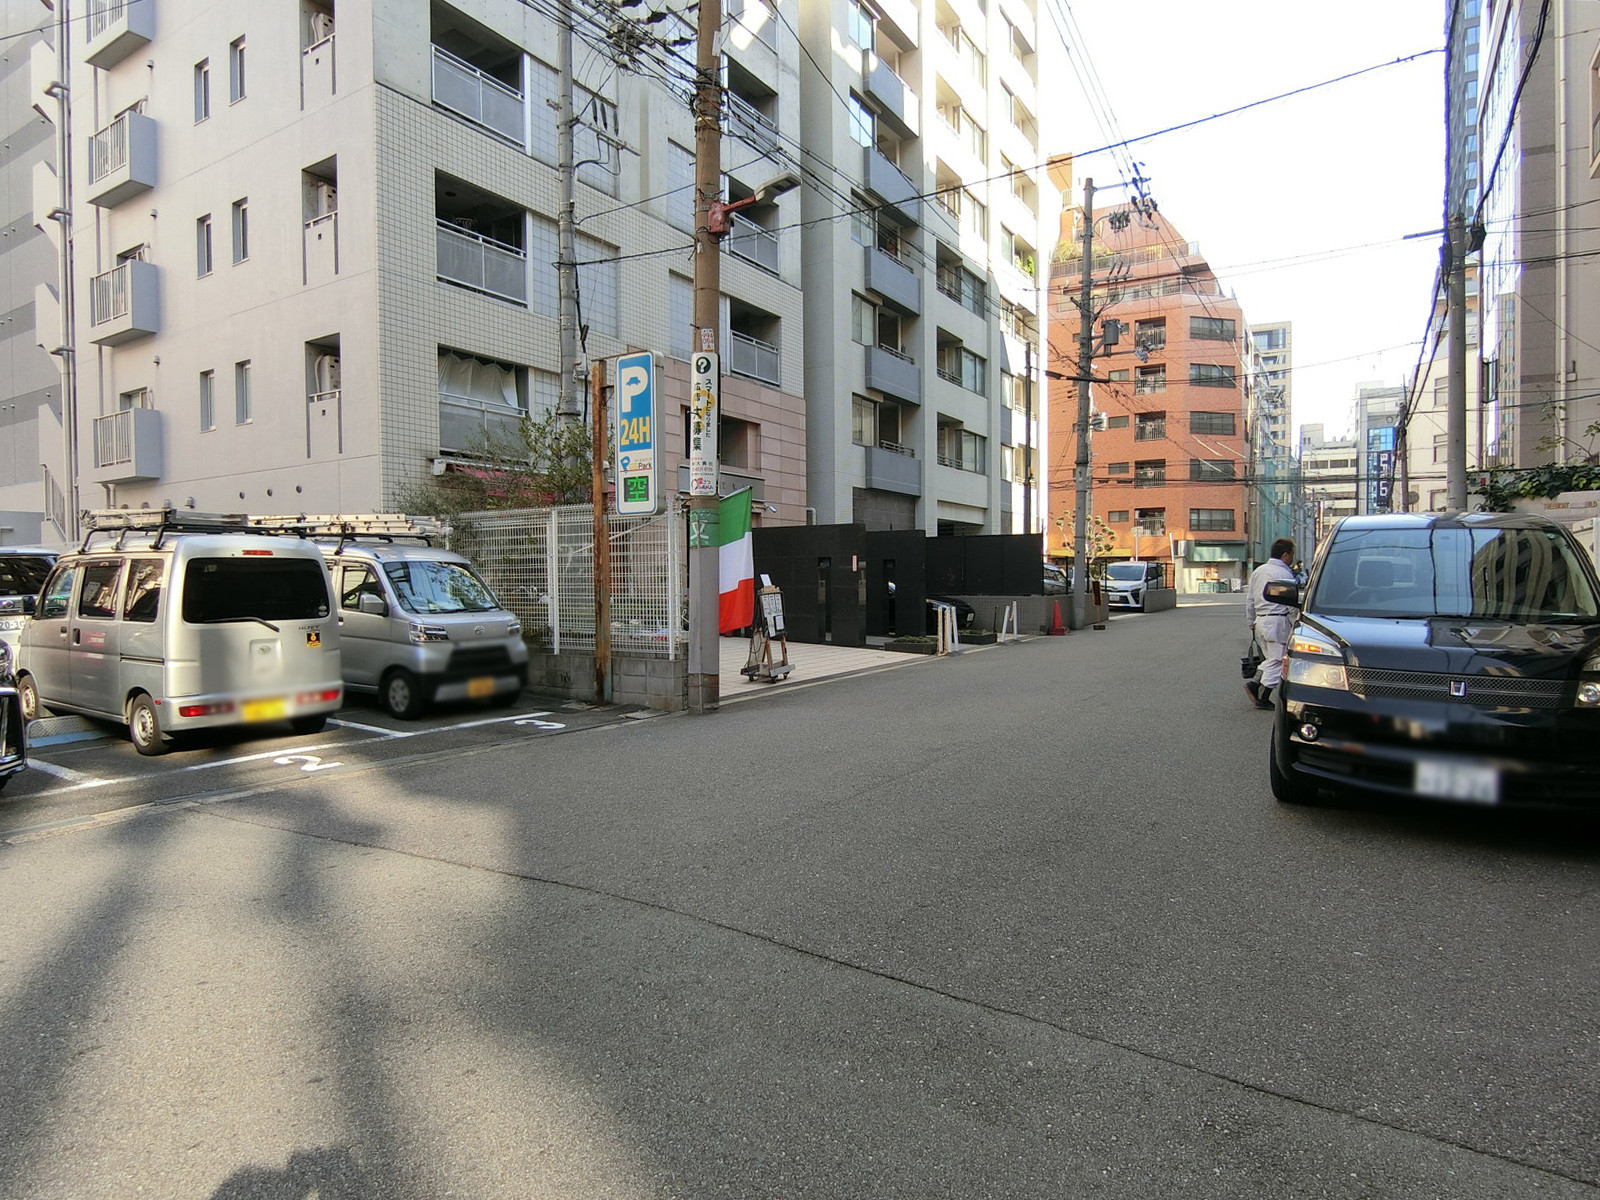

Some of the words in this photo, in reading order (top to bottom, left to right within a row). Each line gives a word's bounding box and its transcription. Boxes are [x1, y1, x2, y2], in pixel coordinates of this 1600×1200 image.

[621, 366, 648, 413] P
[620, 416, 650, 446] 24H
[627, 476, 647, 502] 空
[273, 755, 344, 771] 2
